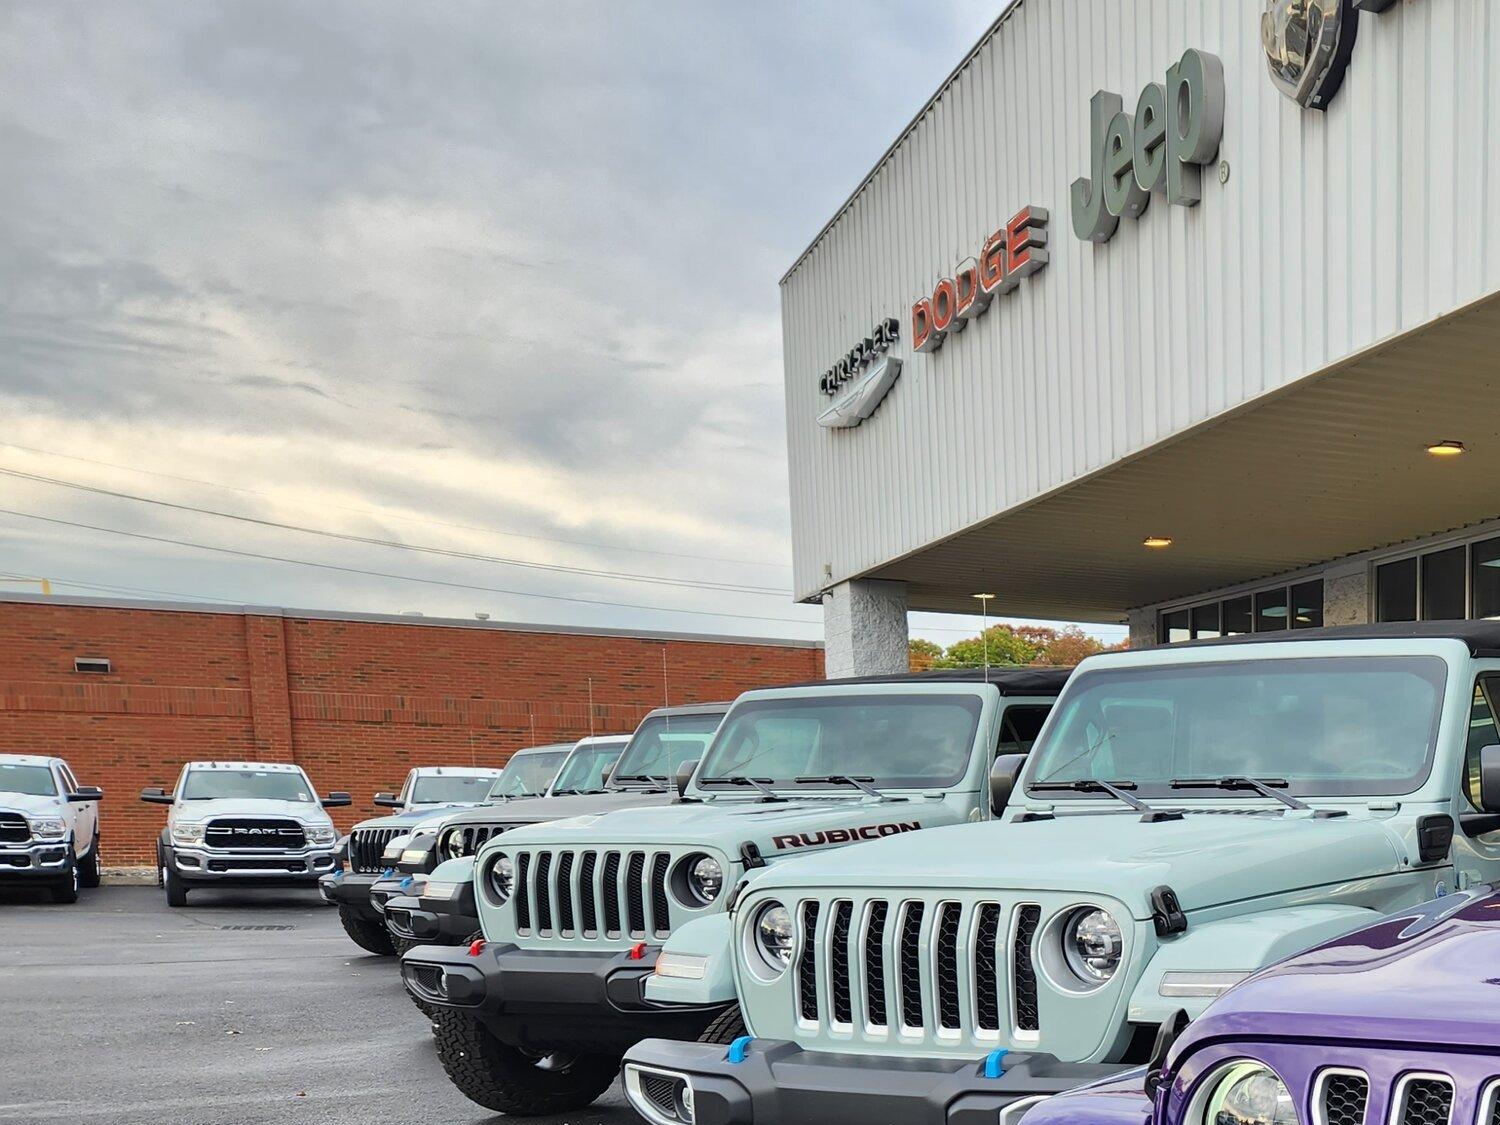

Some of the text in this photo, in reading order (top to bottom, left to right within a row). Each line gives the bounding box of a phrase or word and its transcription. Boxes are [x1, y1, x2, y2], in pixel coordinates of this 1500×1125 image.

[1070, 47, 1225, 243] Jeep
[911, 204, 1049, 353] DODGE
[819, 317, 900, 396] CHRYSLER
[234, 827, 277, 835] RAM
[772, 821, 922, 849] RUBICON
